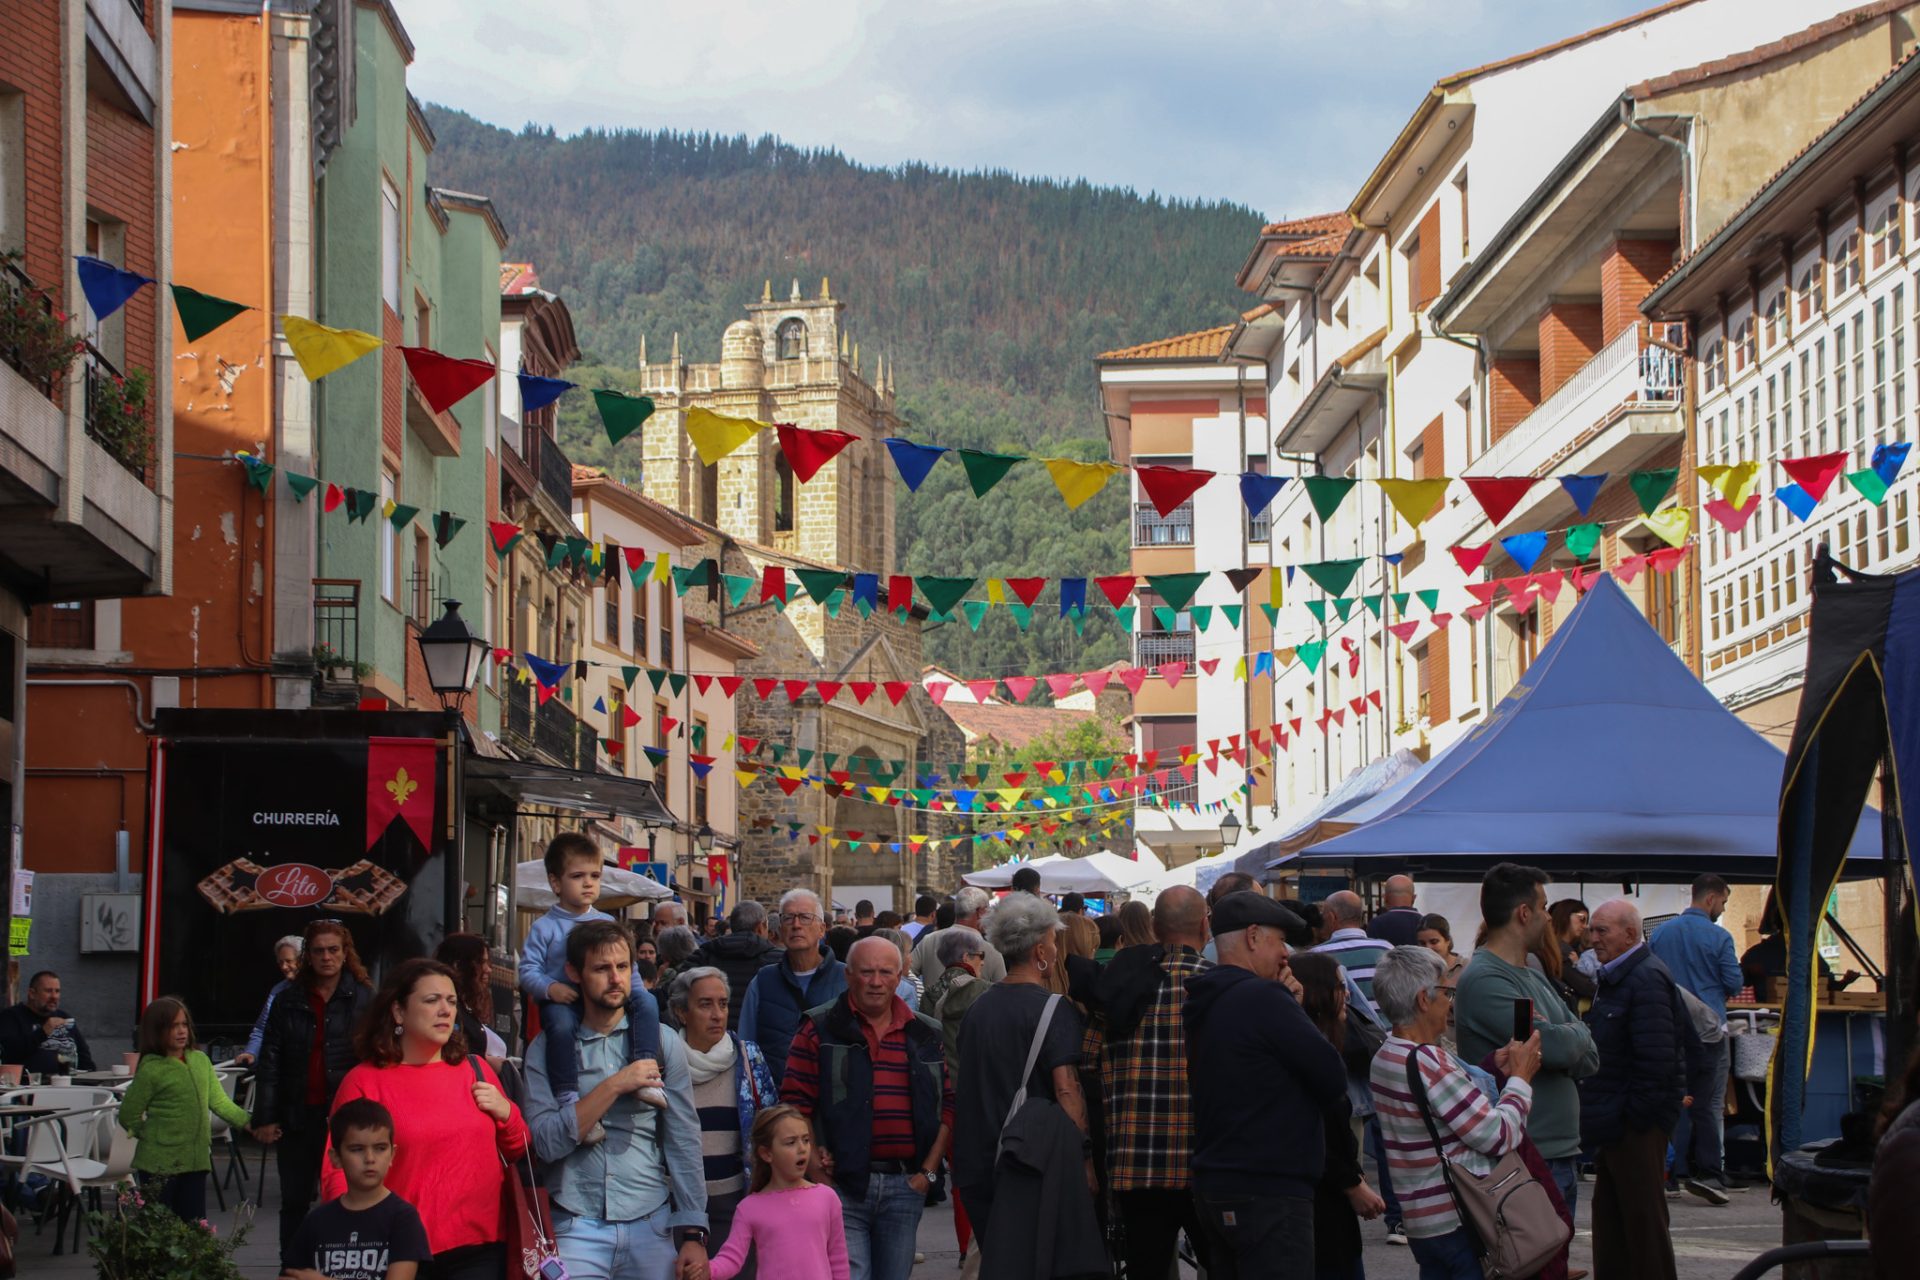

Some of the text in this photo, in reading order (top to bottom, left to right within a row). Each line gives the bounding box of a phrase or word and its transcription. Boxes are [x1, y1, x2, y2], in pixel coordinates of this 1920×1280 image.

[253, 809, 340, 826] CHURRERÍA
[266, 866, 319, 905] Lita
[315, 1249, 389, 1273] LISBOA
